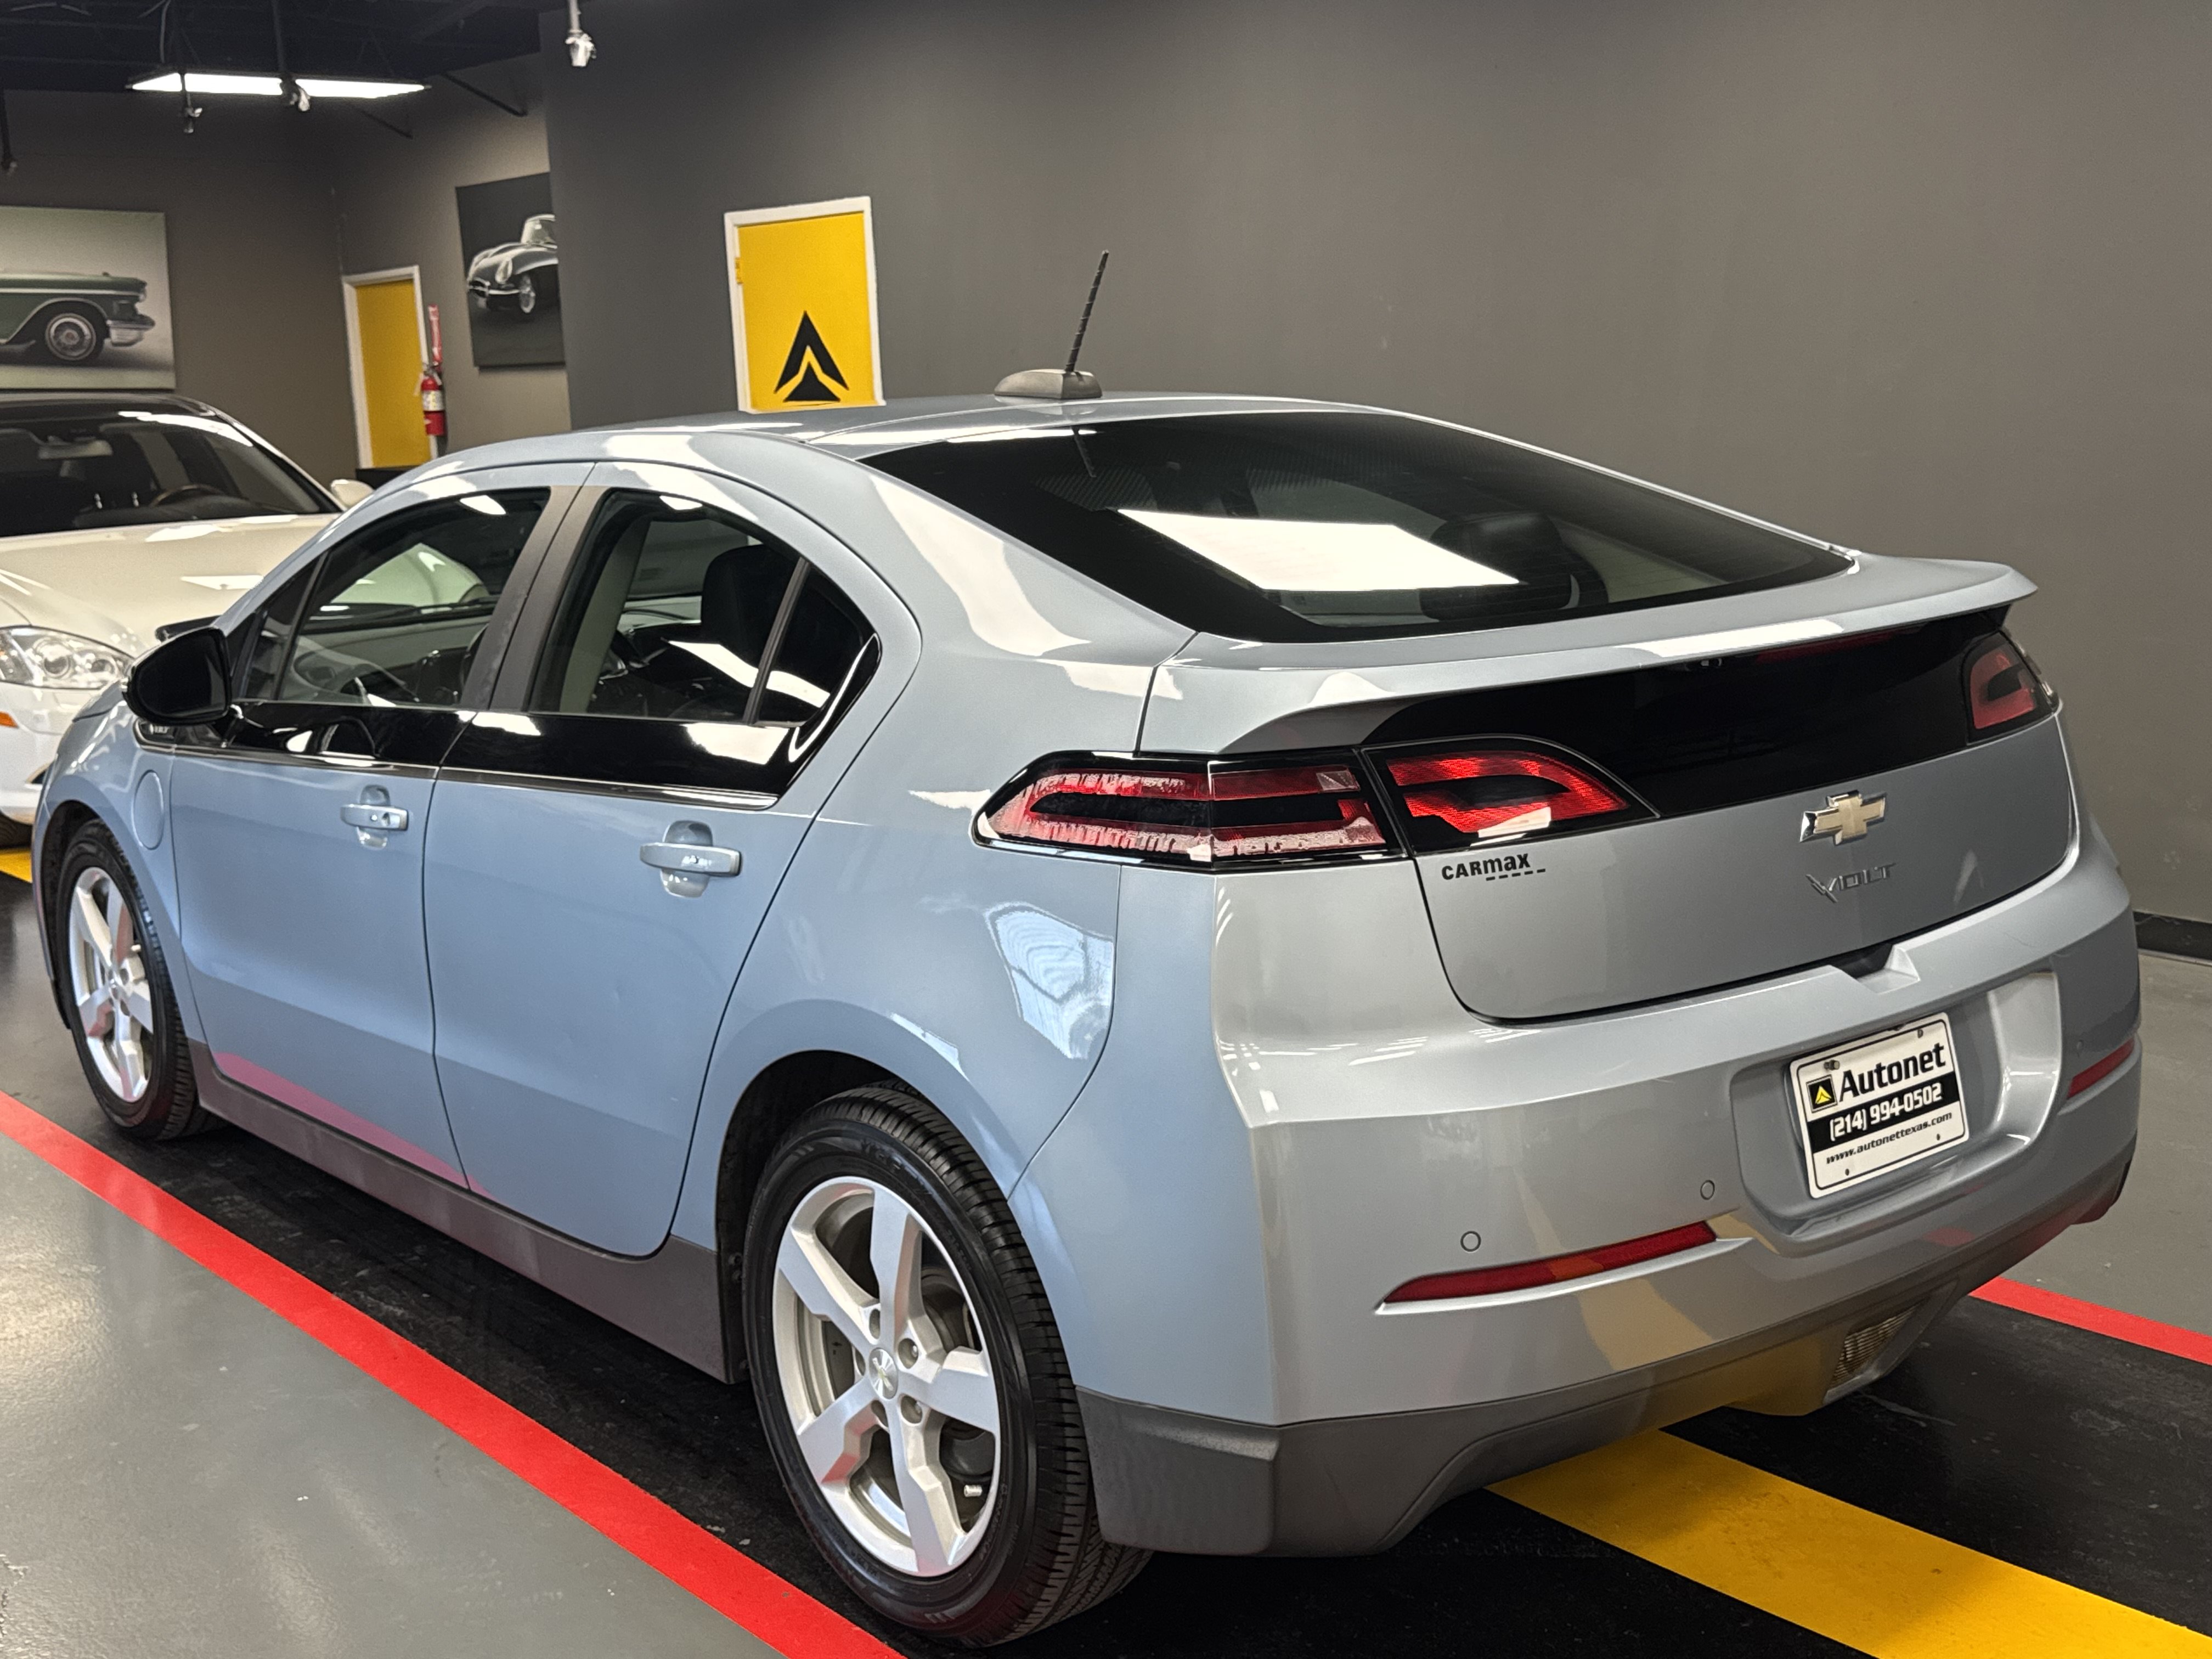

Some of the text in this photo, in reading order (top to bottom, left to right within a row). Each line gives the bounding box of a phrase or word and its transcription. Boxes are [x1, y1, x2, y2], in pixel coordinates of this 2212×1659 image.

[1805, 863, 1897, 903] VOLT
[1839, 1042, 1946, 1102] Autonet
[1826, 1111, 1953, 1165] www.autonettexas.com
[1830, 1082, 1943, 1142] (214) 994-0502
